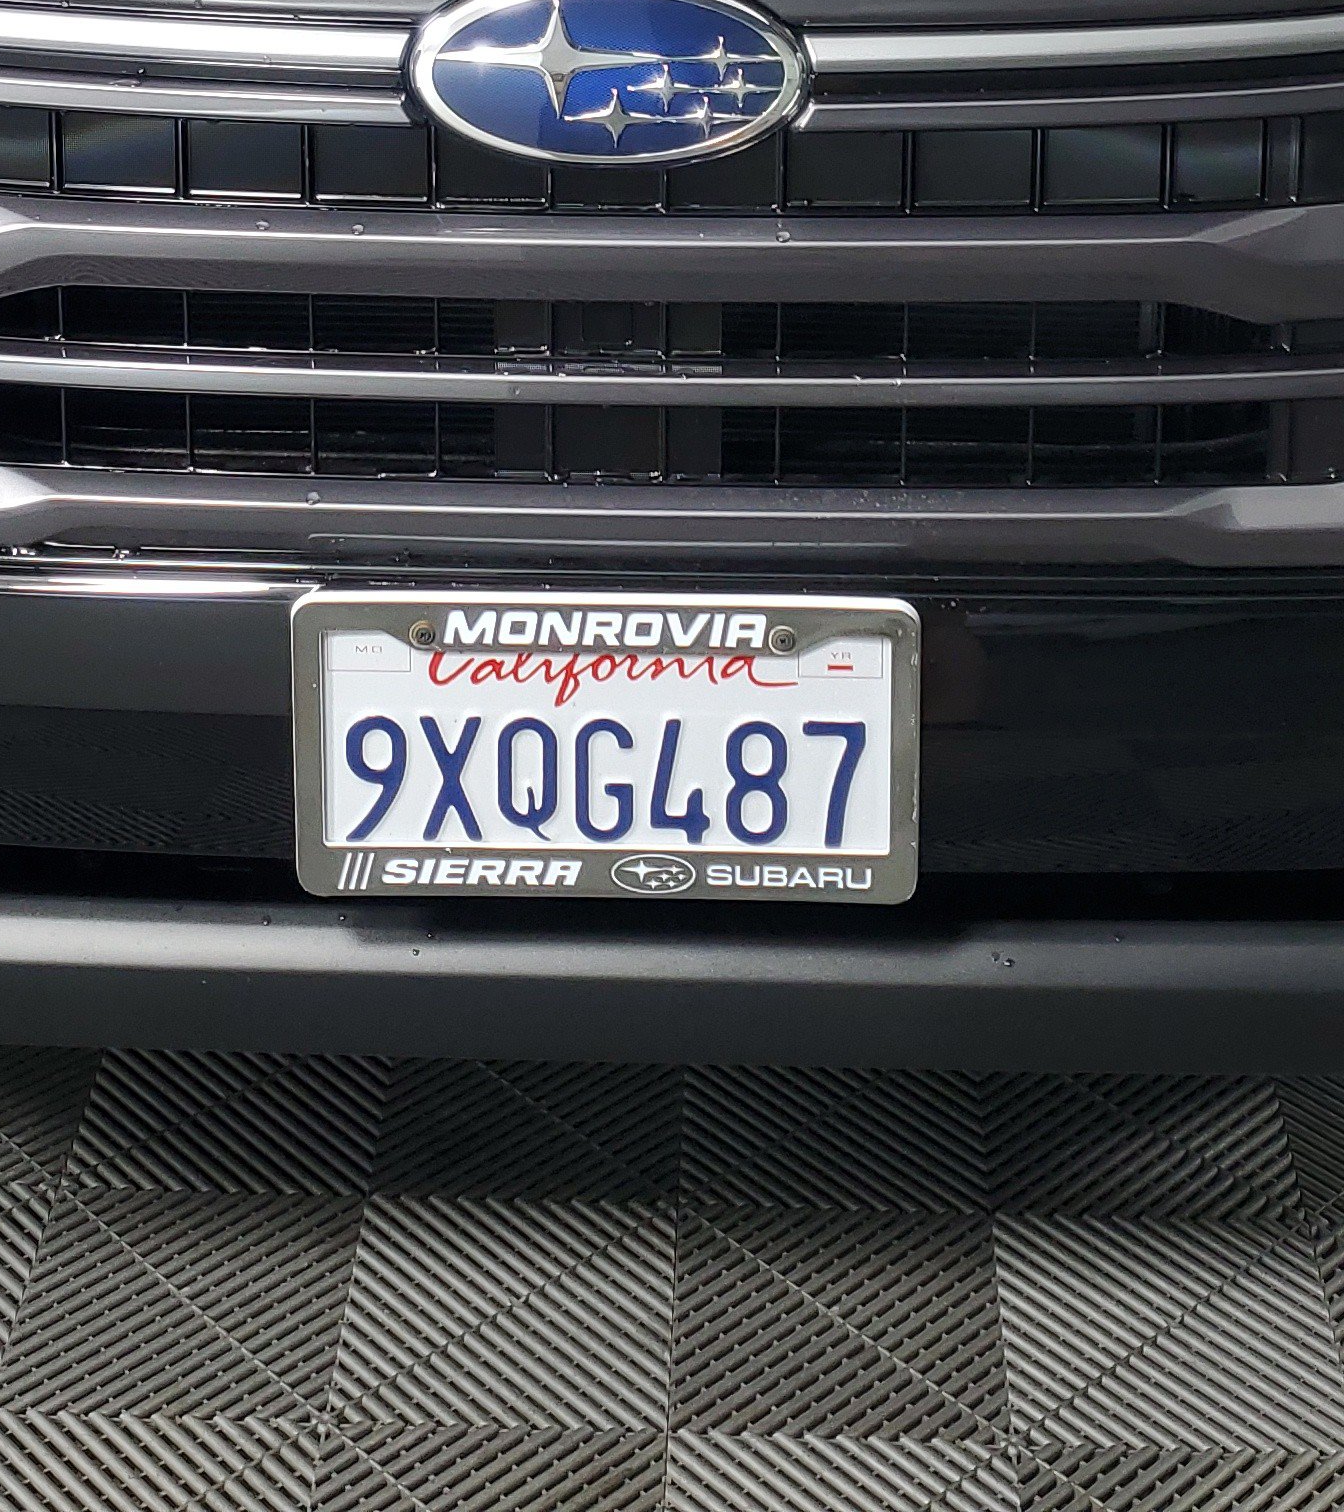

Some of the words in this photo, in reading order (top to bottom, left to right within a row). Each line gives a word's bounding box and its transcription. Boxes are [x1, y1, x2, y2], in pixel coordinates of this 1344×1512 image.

[442, 609, 768, 648] MONROVIA
[355, 645, 383, 654] MO
[830, 651, 852, 660] YR
[428, 650, 799, 708] California
[344, 714, 868, 848] 9XQG487
[381, 857, 584, 887] SIERRA
[705, 862, 874, 890] SUBARU
